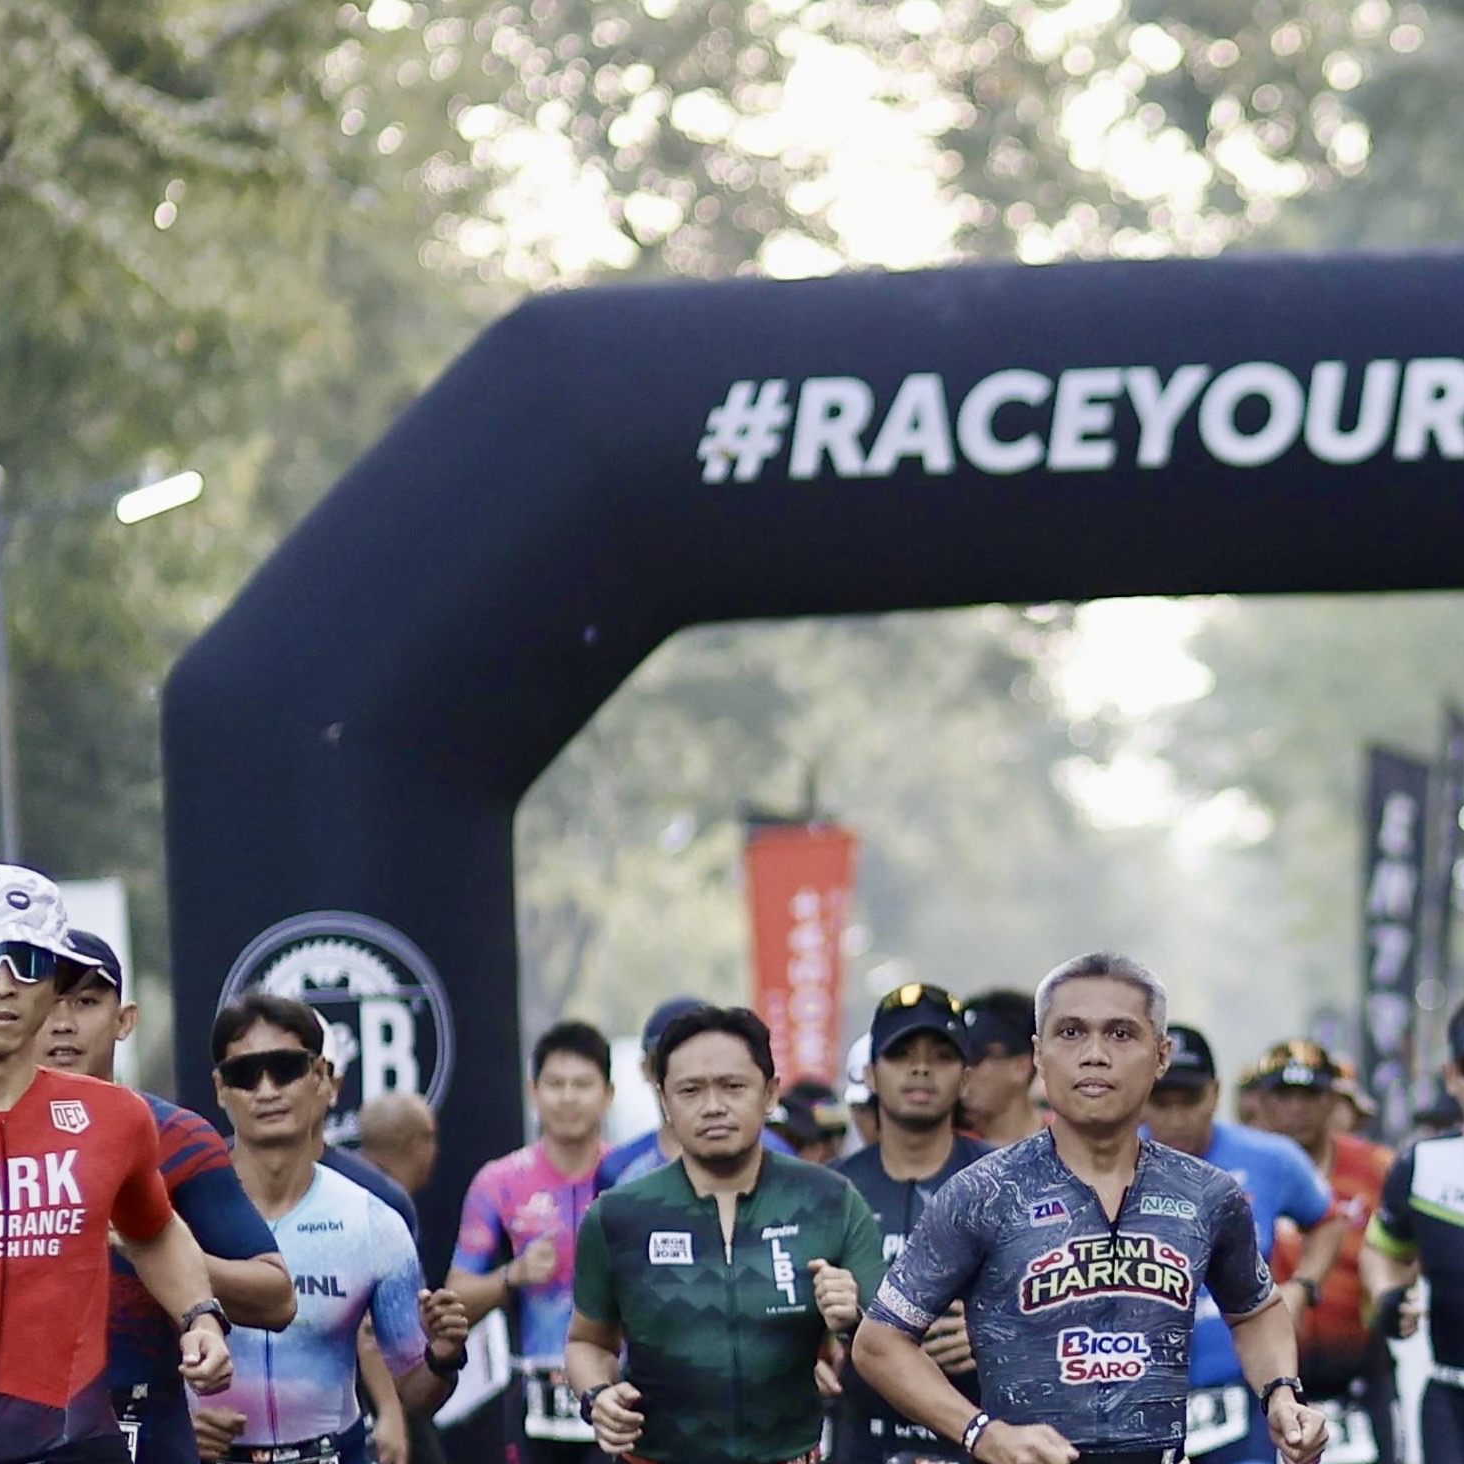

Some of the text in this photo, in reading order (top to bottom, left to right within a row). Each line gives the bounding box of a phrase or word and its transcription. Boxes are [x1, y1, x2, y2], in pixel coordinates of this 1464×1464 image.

[53, 1106, 86, 1129] DEC
[1032, 1200, 1065, 1220] ZIA
[1141, 1195, 1196, 1218] NAC
[1074, 1238, 1149, 1262] TEAM
[1031, 1260, 1186, 1304] HARKOR
[1062, 1331, 1148, 1358] BICOL
[1065, 1359, 1142, 1381] SARO
